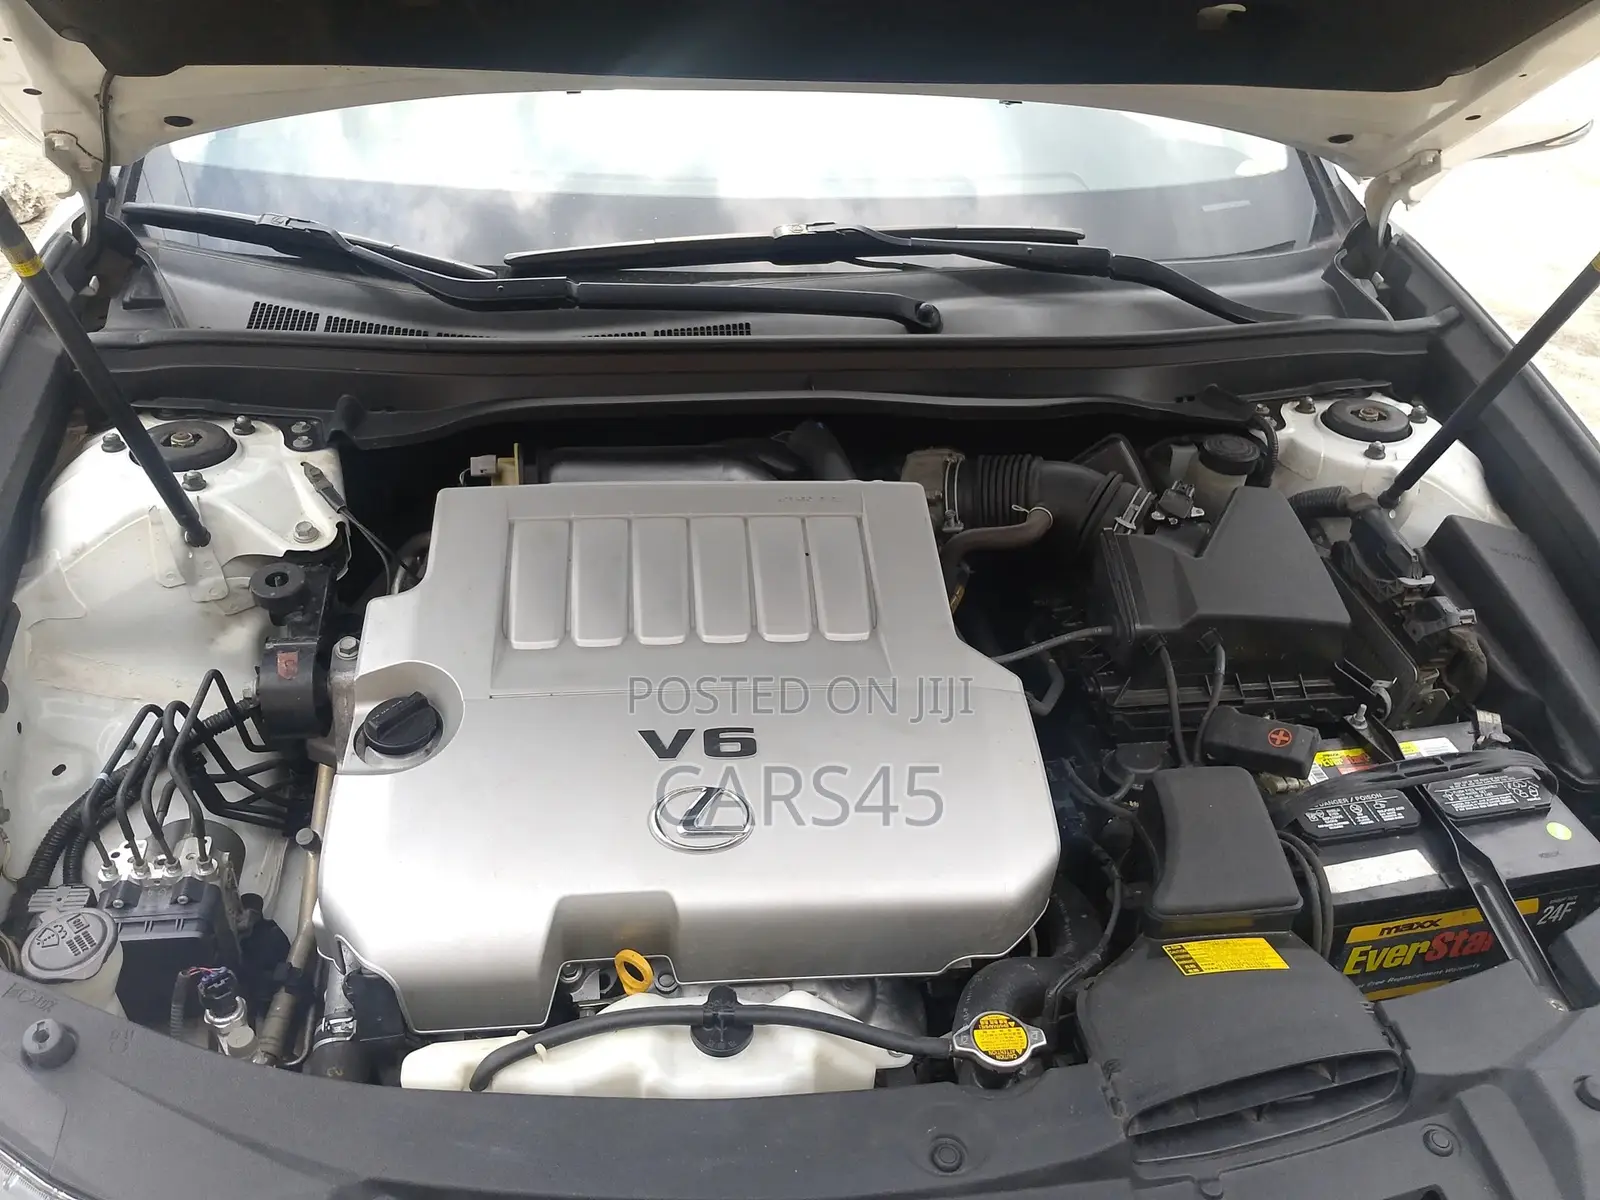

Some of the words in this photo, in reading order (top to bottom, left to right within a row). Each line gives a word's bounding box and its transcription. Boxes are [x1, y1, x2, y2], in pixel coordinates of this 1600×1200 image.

[638, 727, 758, 760] V6
[1354, 792, 1383, 802] POISON
[1536, 901, 1577, 926] 24F
[1379, 917, 1443, 937] maxx
